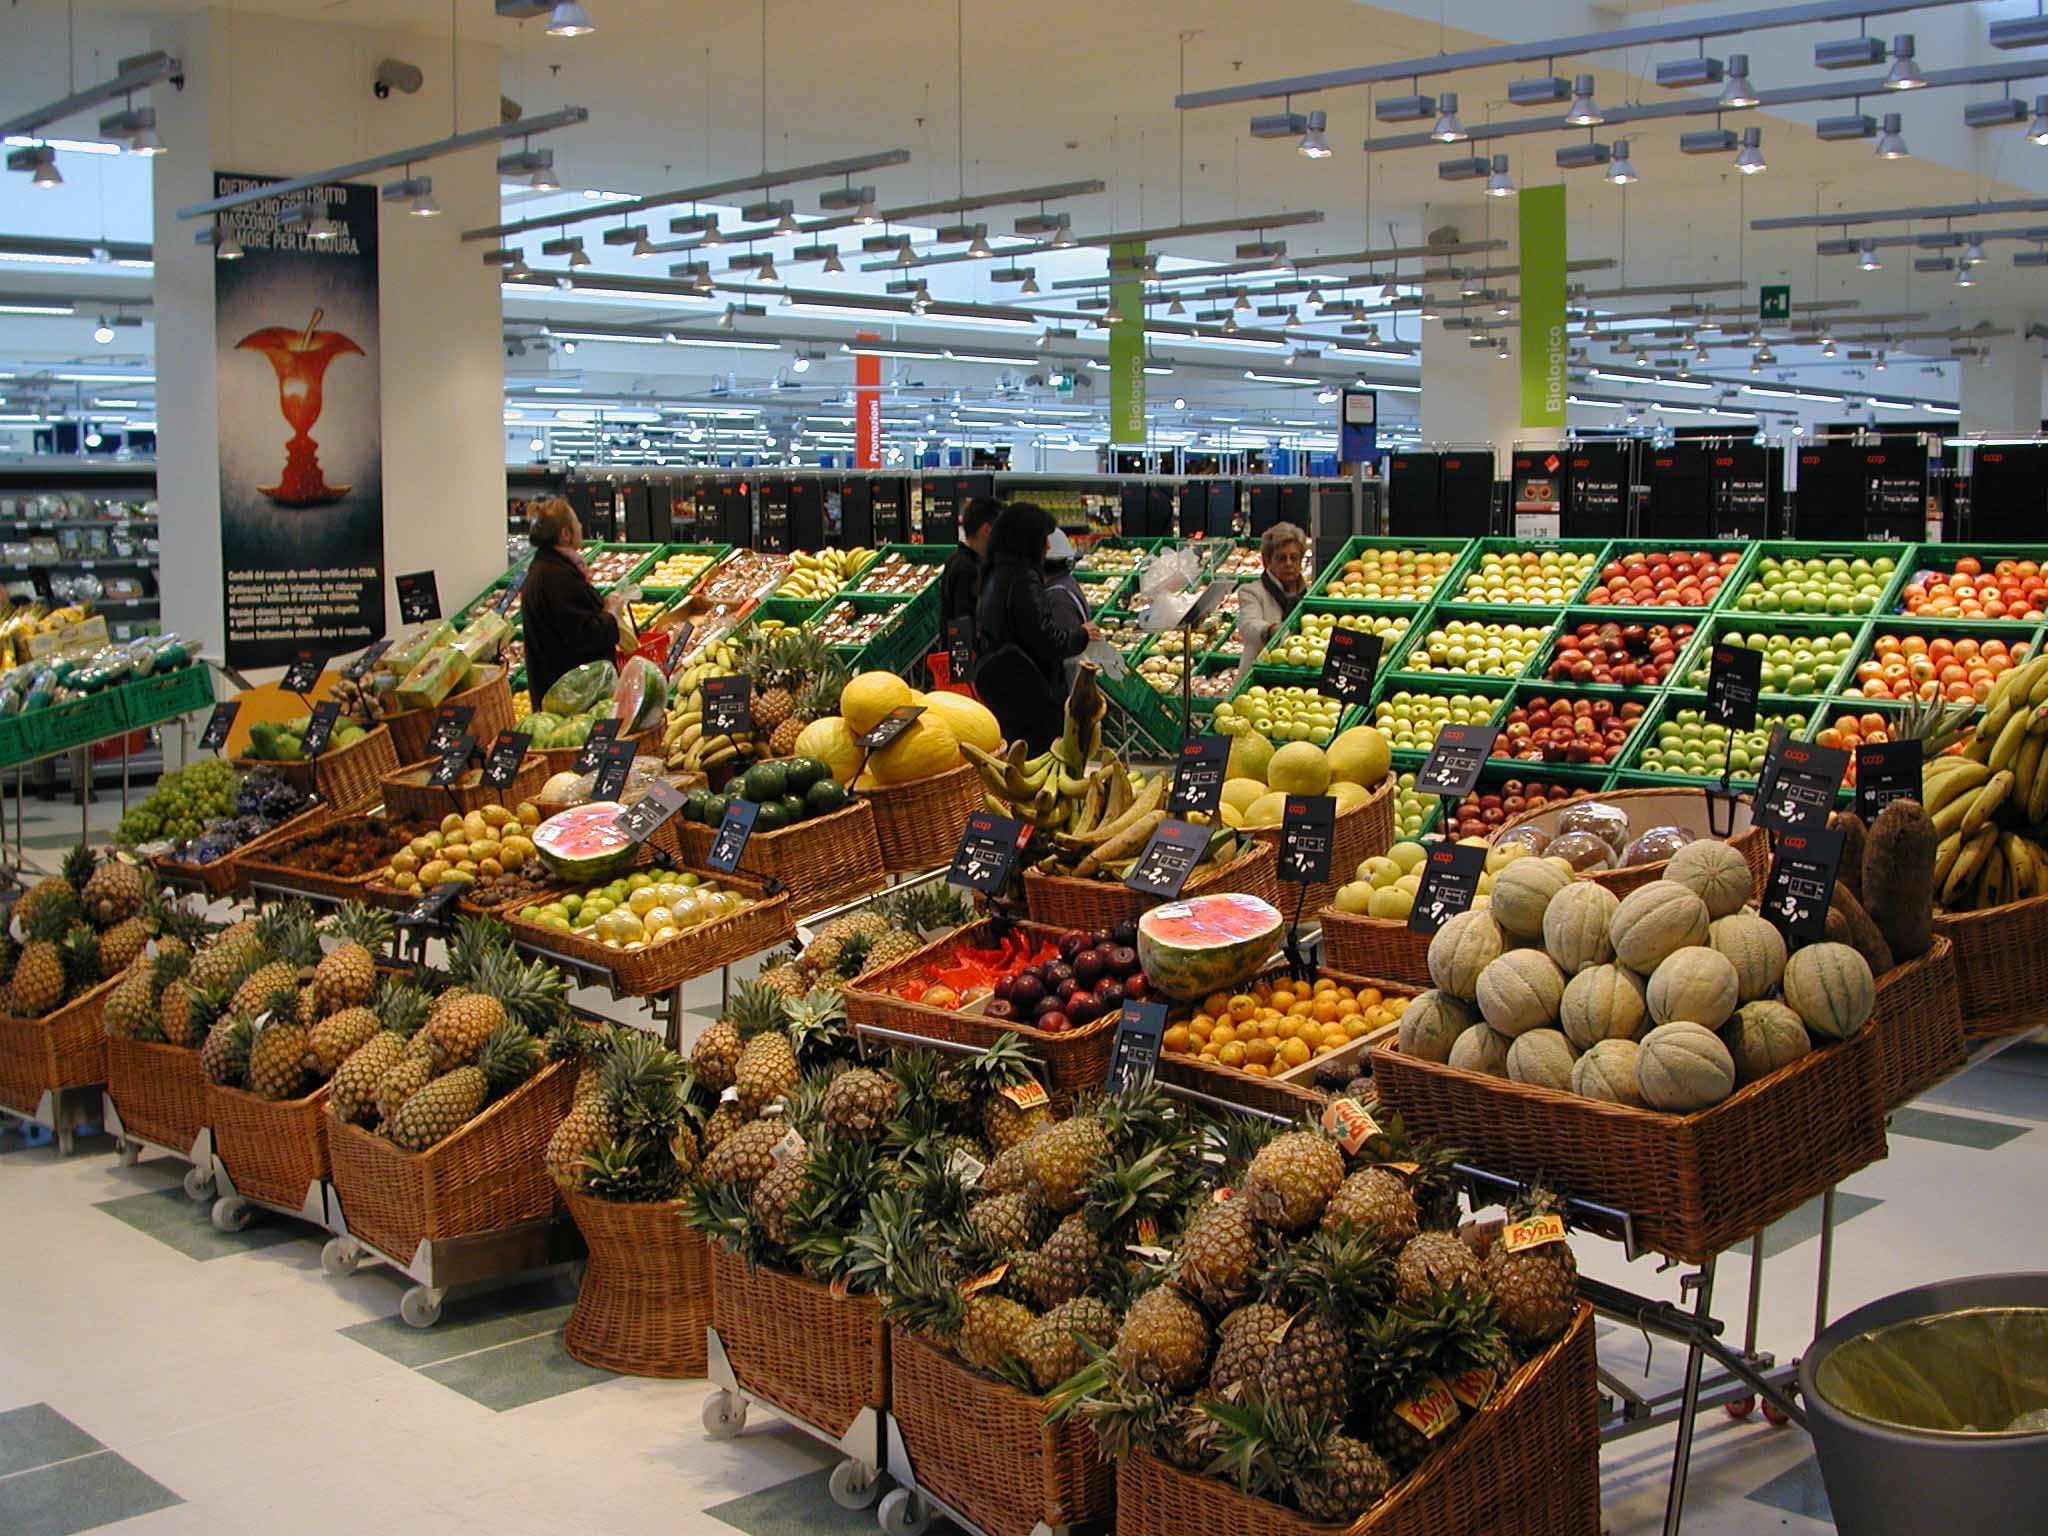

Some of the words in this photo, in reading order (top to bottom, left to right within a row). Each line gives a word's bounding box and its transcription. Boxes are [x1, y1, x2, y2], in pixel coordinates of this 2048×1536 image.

[273, 233, 297, 250] PER
[1129, 355, 1143, 431] Biologico
[1546, 325, 1564, 412] Biologico
[869, 400, 880, 463] Promozioni
[1513, 1222, 1559, 1244] Ryna
